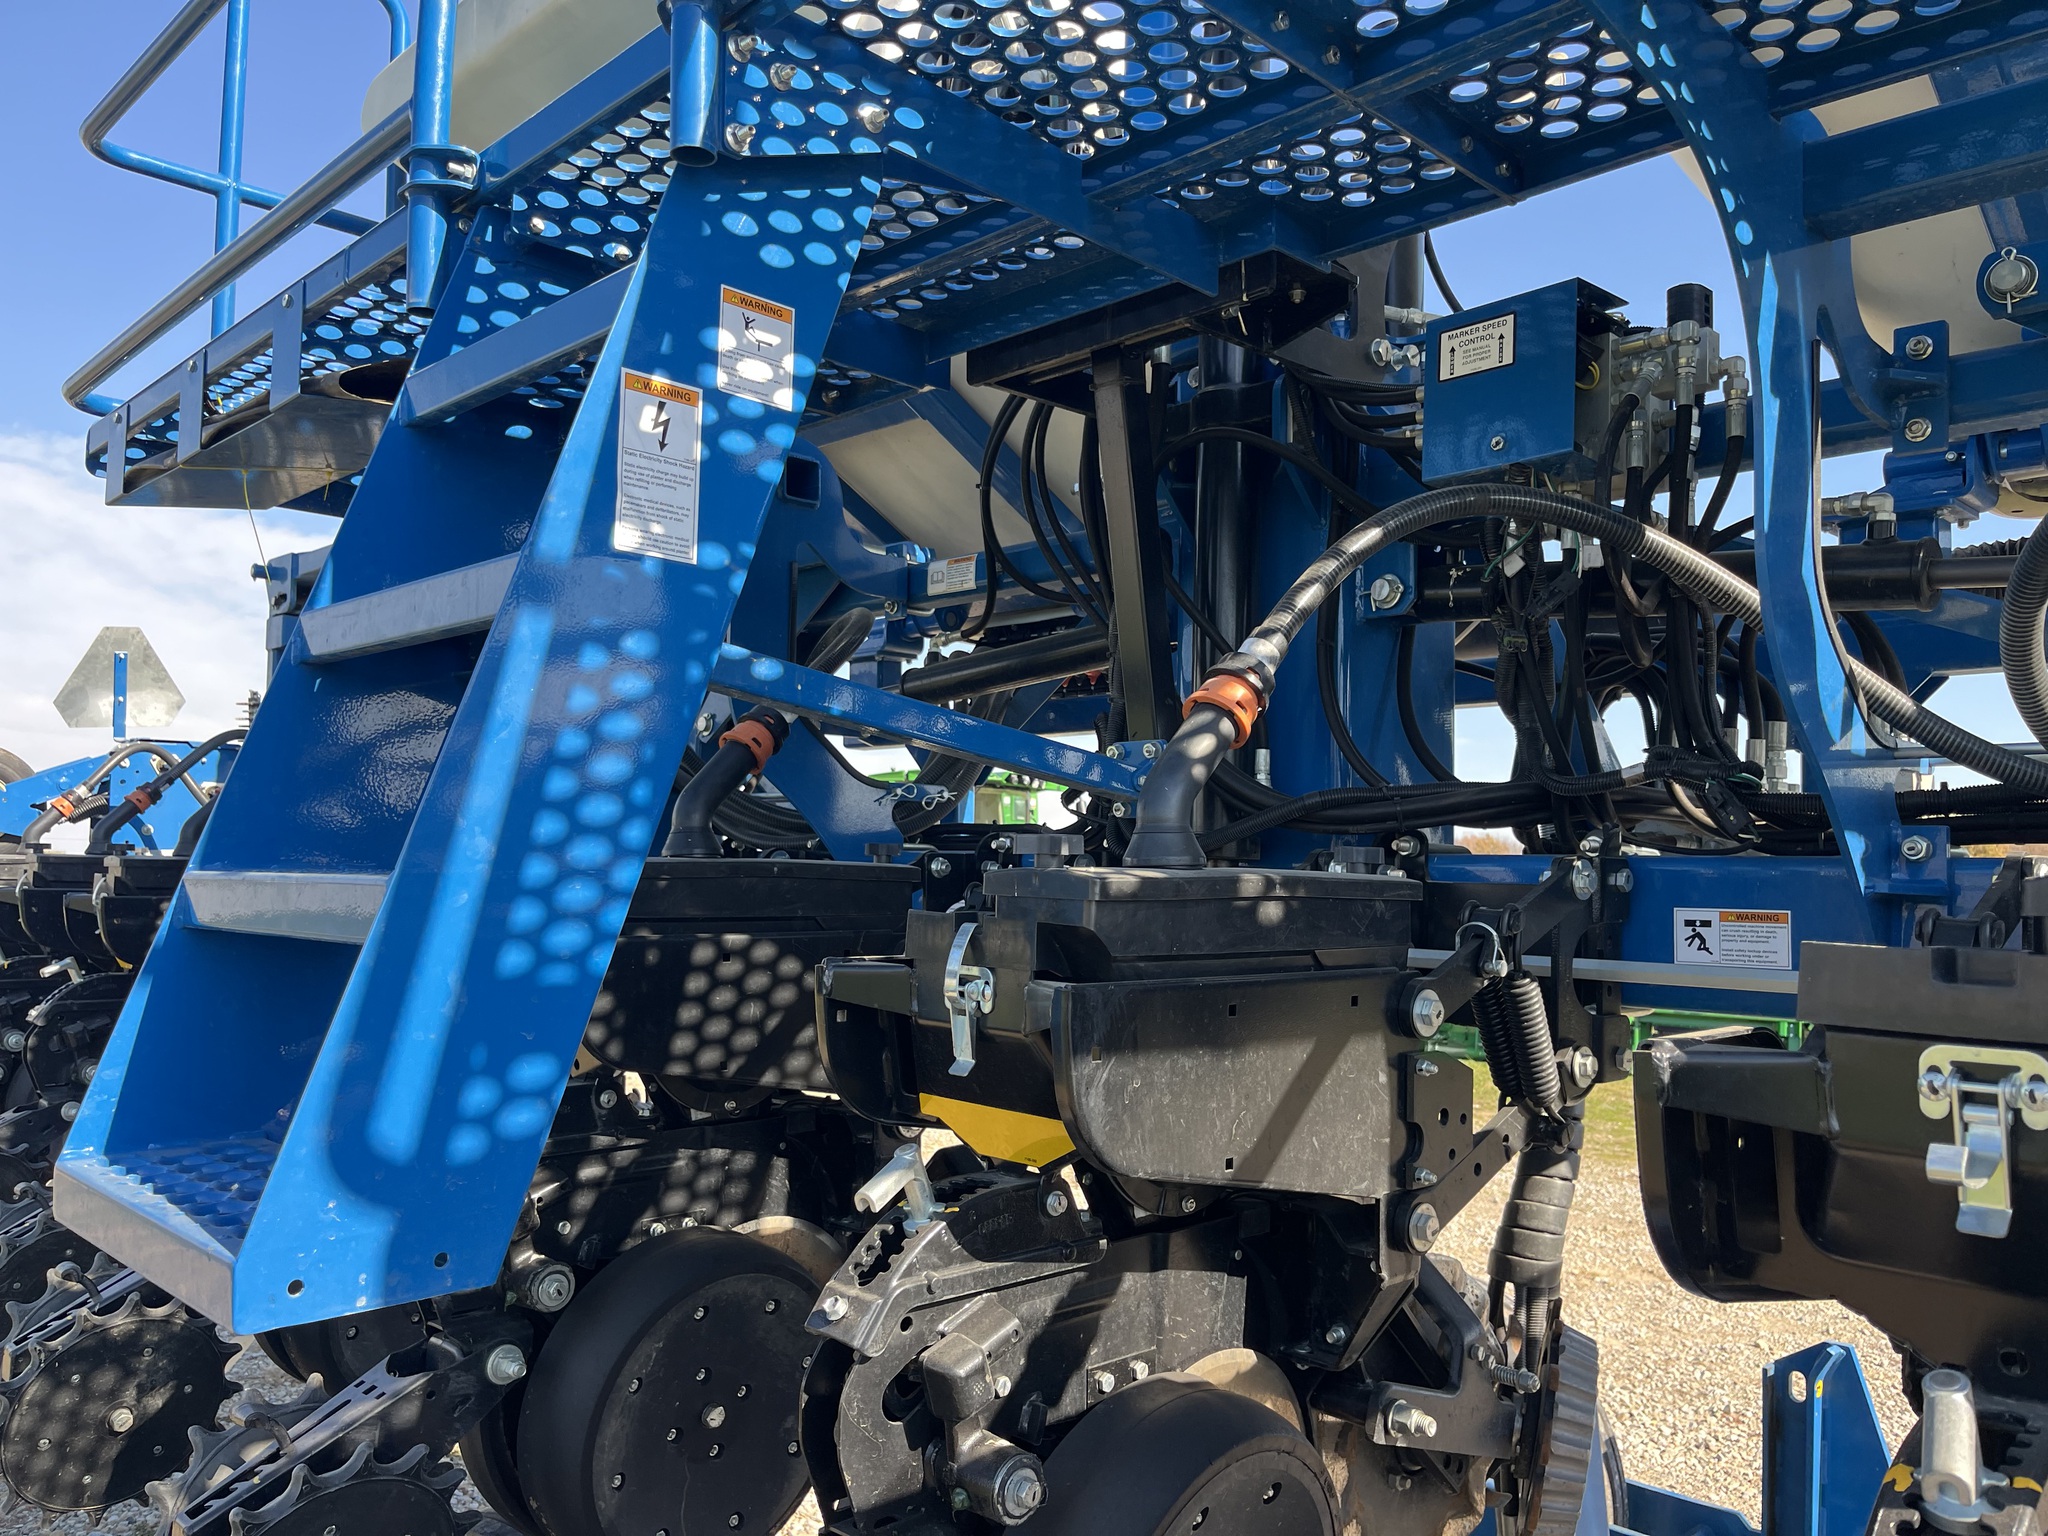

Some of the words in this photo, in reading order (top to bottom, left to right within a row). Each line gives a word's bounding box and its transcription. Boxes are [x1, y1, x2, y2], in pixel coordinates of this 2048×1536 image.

[740, 296, 783, 318] WARNING
[1448, 326, 1480, 341] MARKER
[1482, 319, 1508, 332] SPEED
[1458, 333, 1495, 348] CONTROL
[1472, 344, 1491, 352] MANUAL
[1462, 355, 1491, 366] ADJUSTMENT
[1473, 349, 1491, 357] PROPER
[643, 381, 691, 402] WARNING
[624, 450, 638, 458] Static
[639, 453, 662, 464] Electricity
[679, 463, 695, 471] Hazard
[636, 464, 655, 473] electricity
[624, 468, 637, 476] during
[673, 479, 691, 487] discharge
[1735, 913, 1779, 921] WARNING
